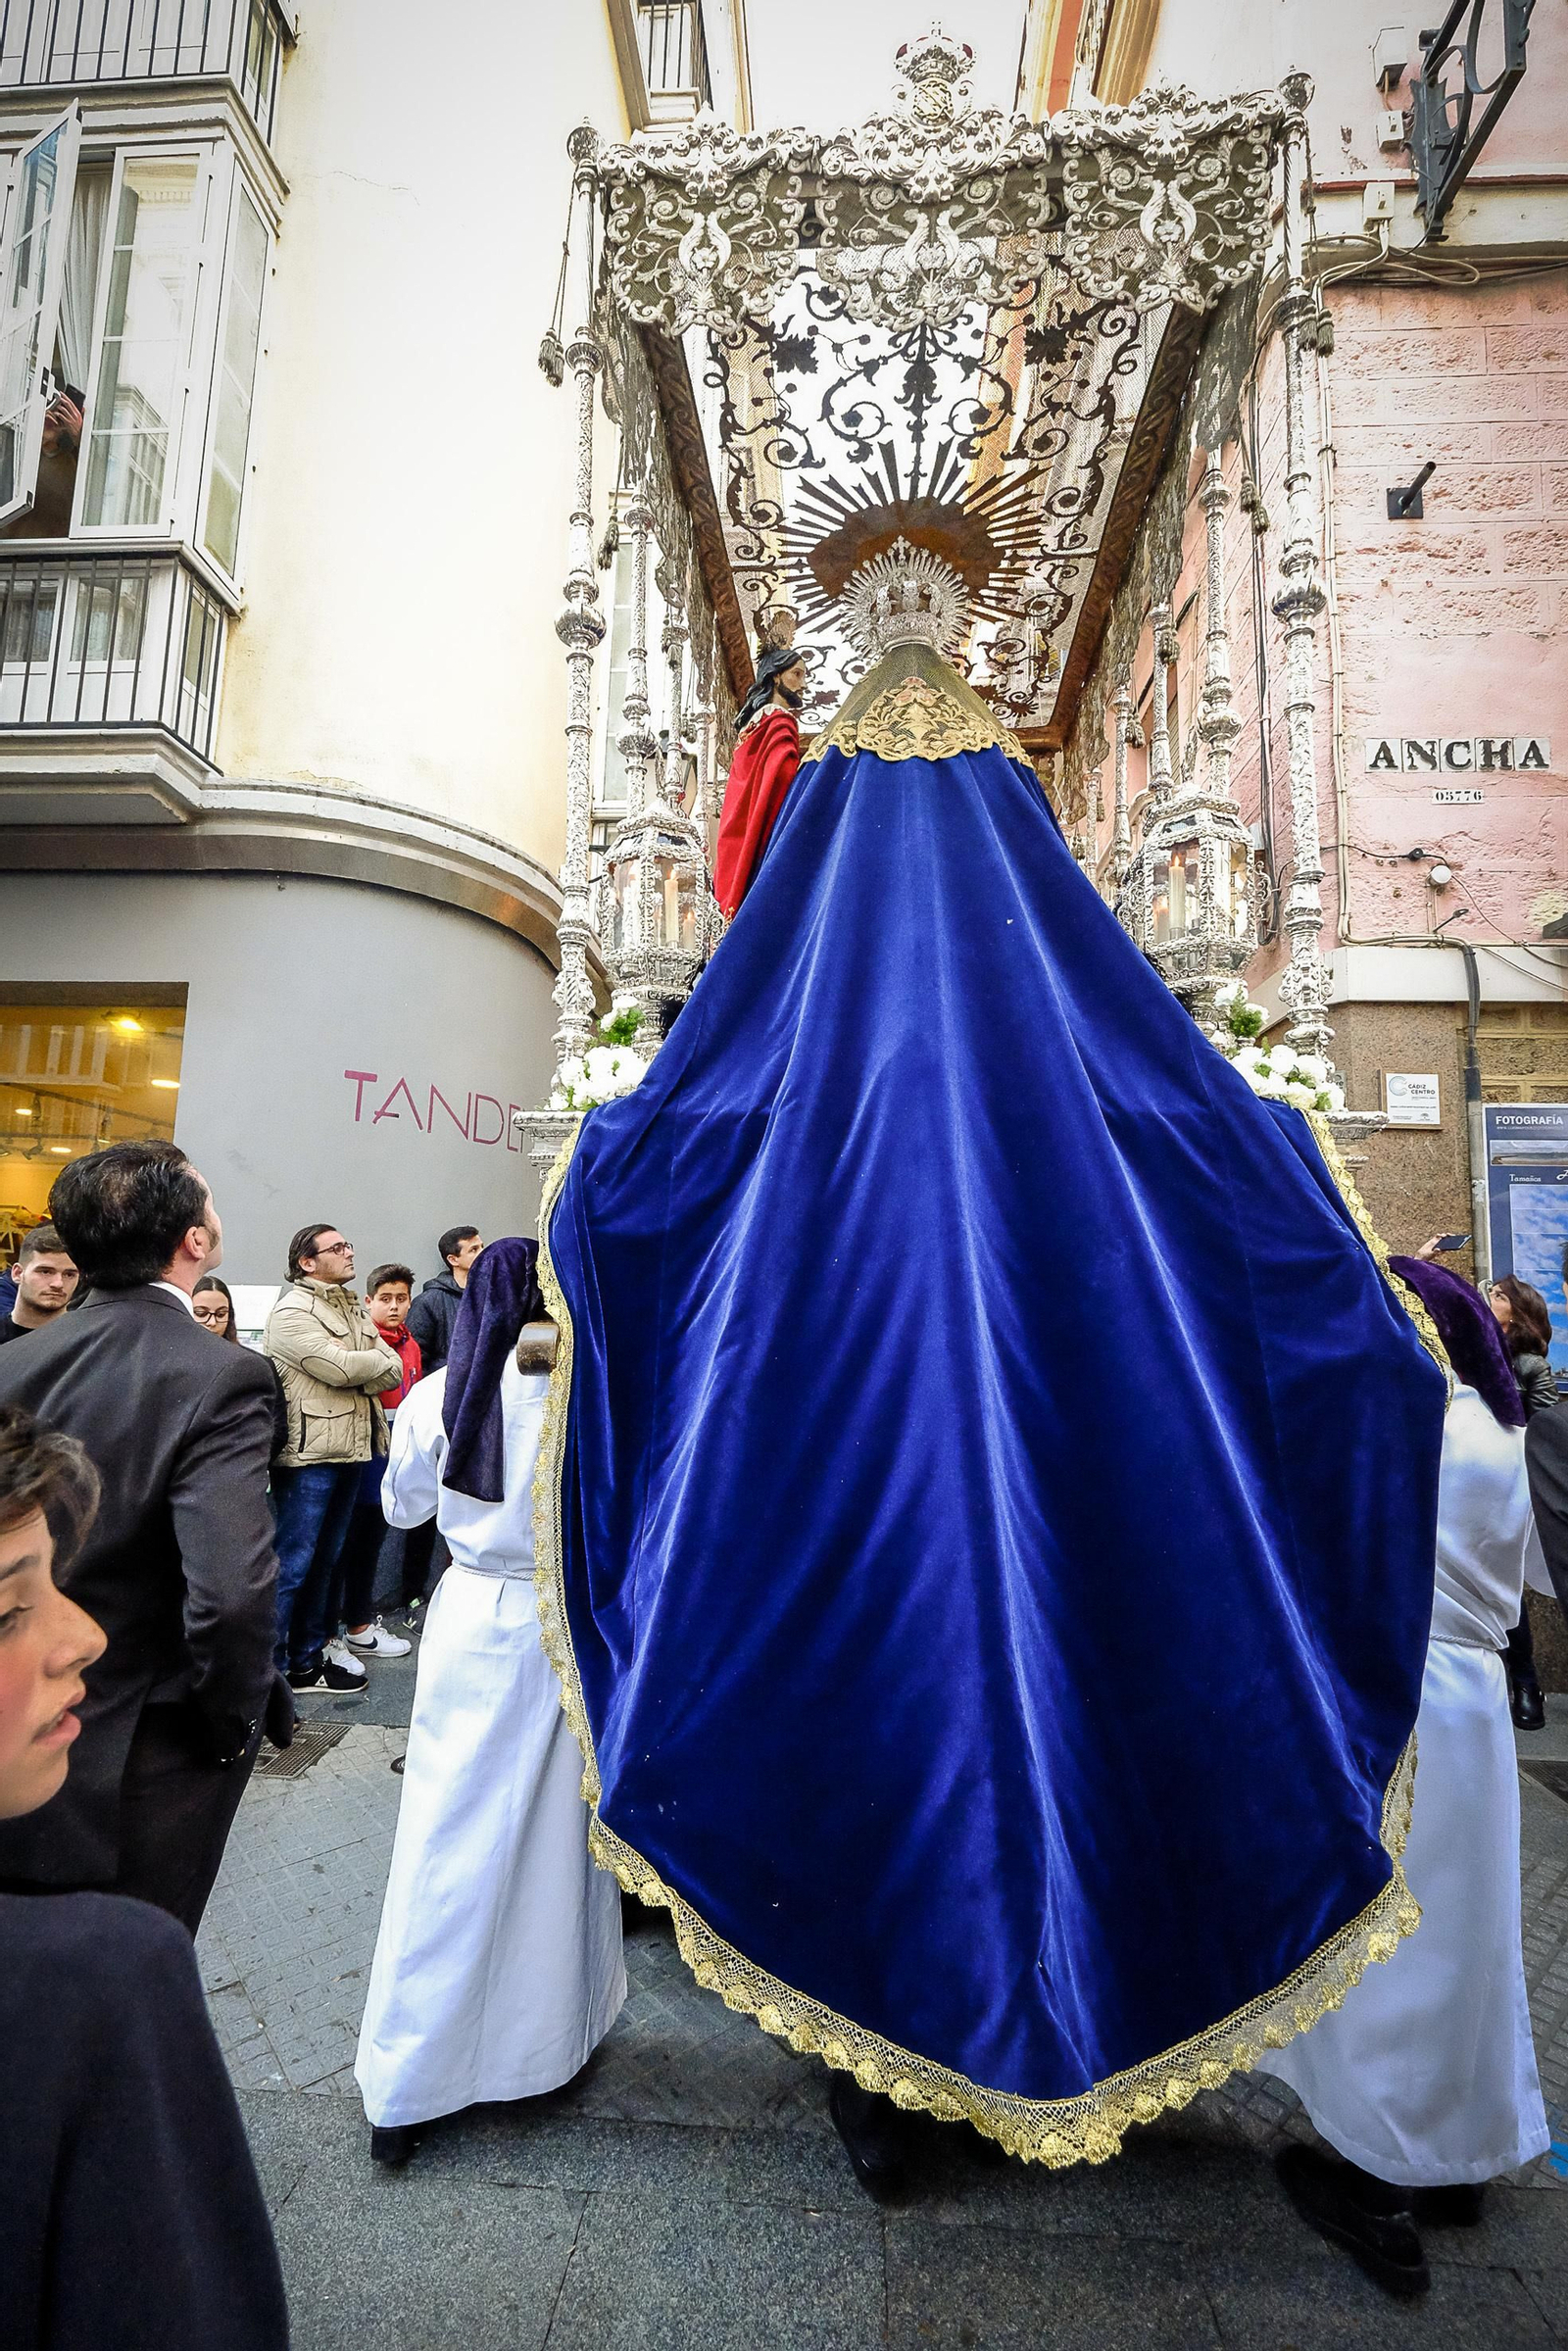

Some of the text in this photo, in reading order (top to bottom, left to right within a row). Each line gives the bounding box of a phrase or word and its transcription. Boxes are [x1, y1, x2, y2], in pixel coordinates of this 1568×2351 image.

[1369, 739, 1549, 770] ANCHA
[1435, 790, 1482, 802] 05776
[344, 1069, 524, 1153] TANDE
[1495, 1113, 1564, 1125] FOTOGRAFÍA
[1509, 1173, 1542, 1182] Tamaños
